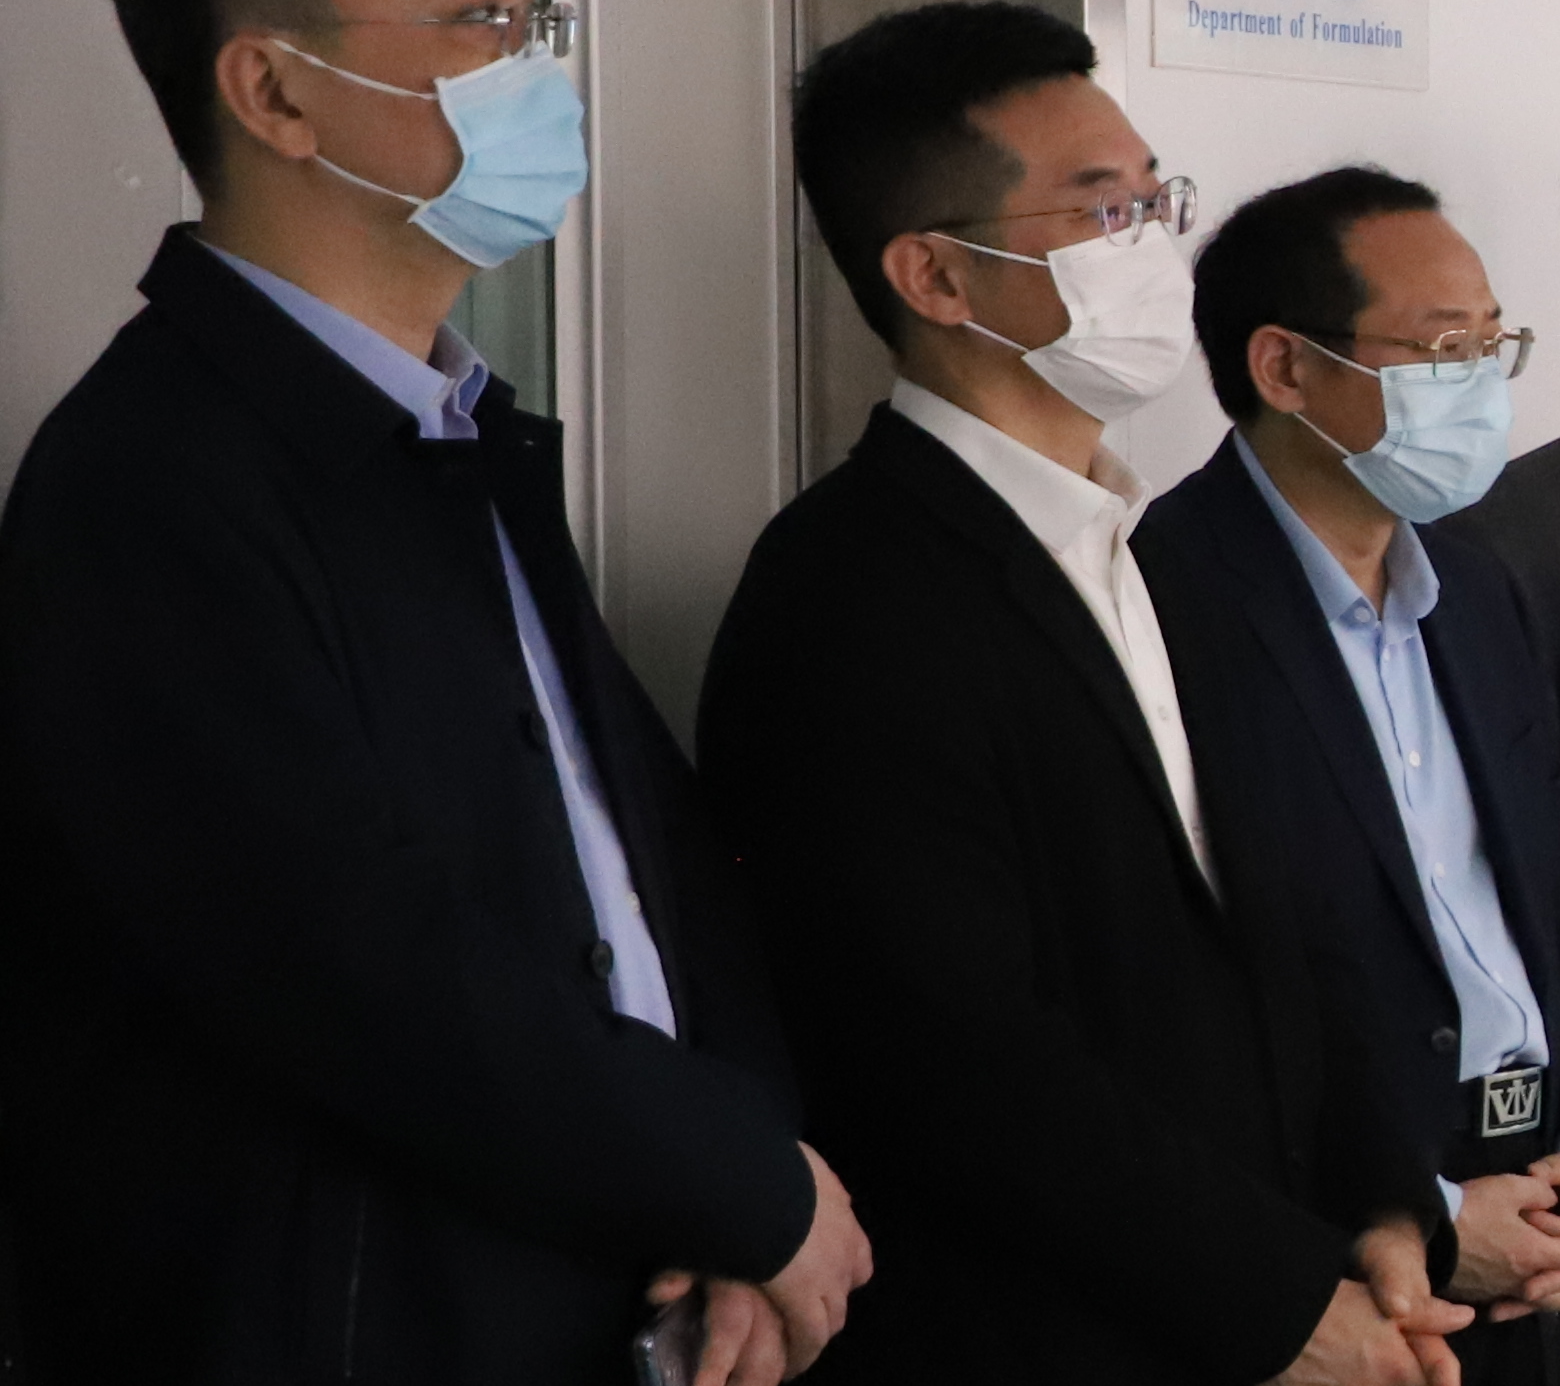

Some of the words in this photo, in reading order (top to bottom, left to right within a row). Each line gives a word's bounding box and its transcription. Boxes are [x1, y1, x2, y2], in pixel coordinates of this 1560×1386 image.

[1188, 0, 1283, 39] Department
[1290, 12, 1306, 39] of
[1313, 13, 1403, 49] Formulation
